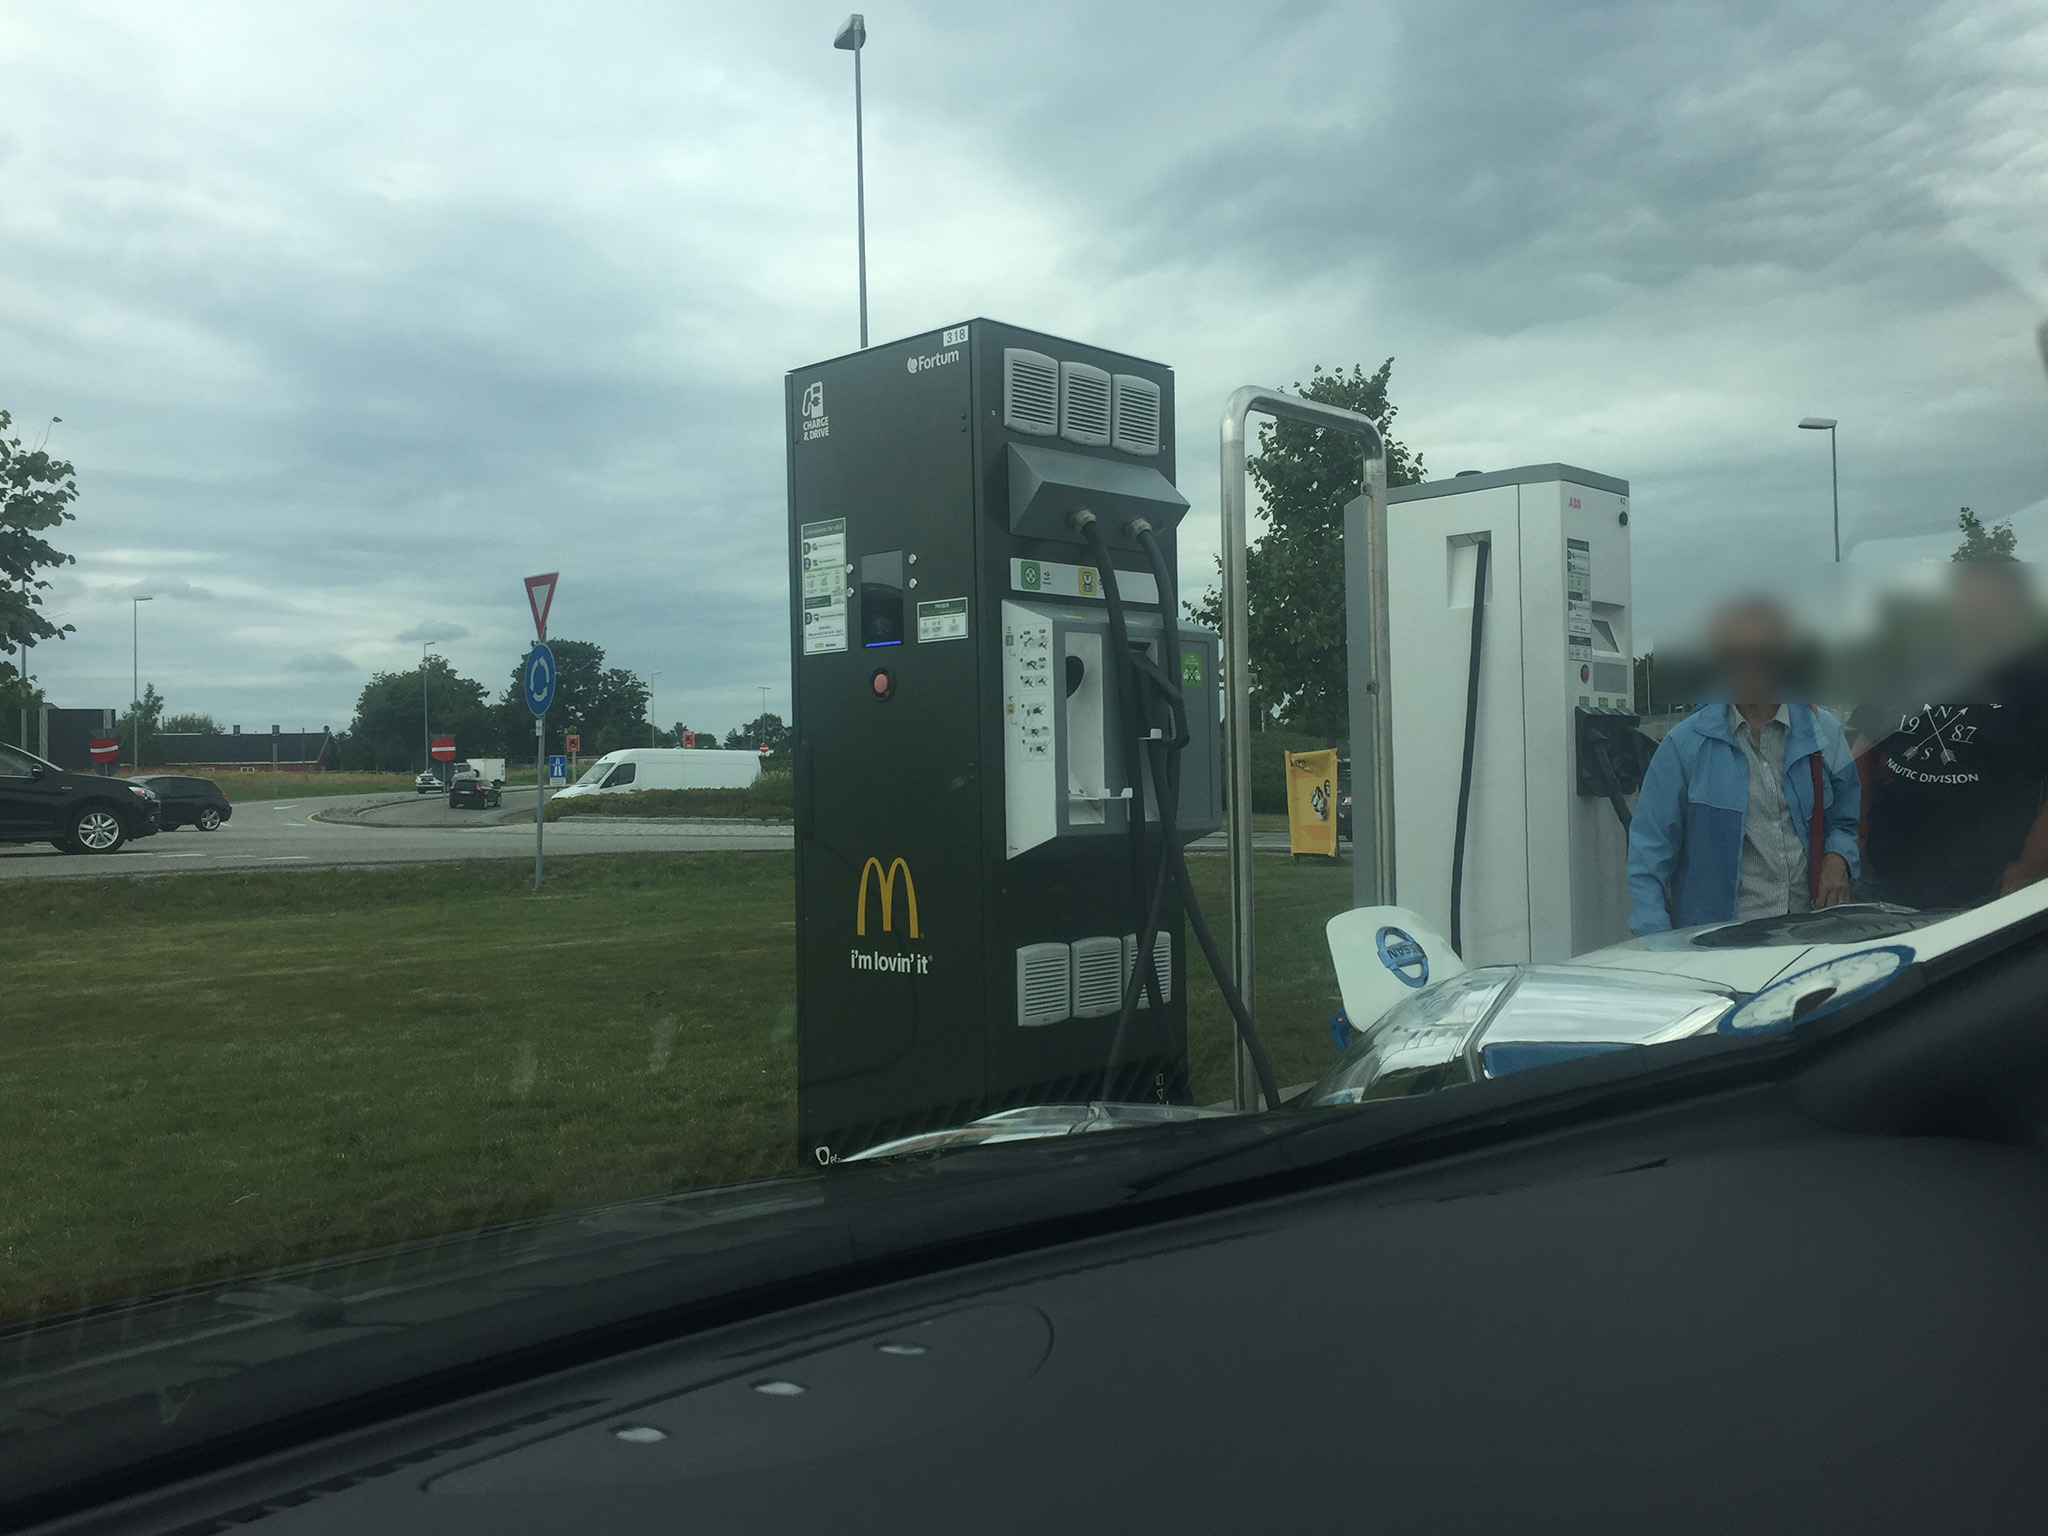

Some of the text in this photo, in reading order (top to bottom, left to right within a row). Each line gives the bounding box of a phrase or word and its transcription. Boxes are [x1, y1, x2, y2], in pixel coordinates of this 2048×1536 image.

[946, 328, 965, 343] 318
[918, 350, 959, 371] Fortum
[803, 416, 829, 431] CHARGE
[803, 426, 830, 440] & DRIVE
[1569, 497, 1581, 509] ABB
[1951, 724, 1977, 742] 87
[1921, 747, 1934, 760] S
[1886, 757, 1979, 784] NAUTIC DIVISION
[851, 949, 872, 970] i'm
[874, 951, 914, 974] lovin'
